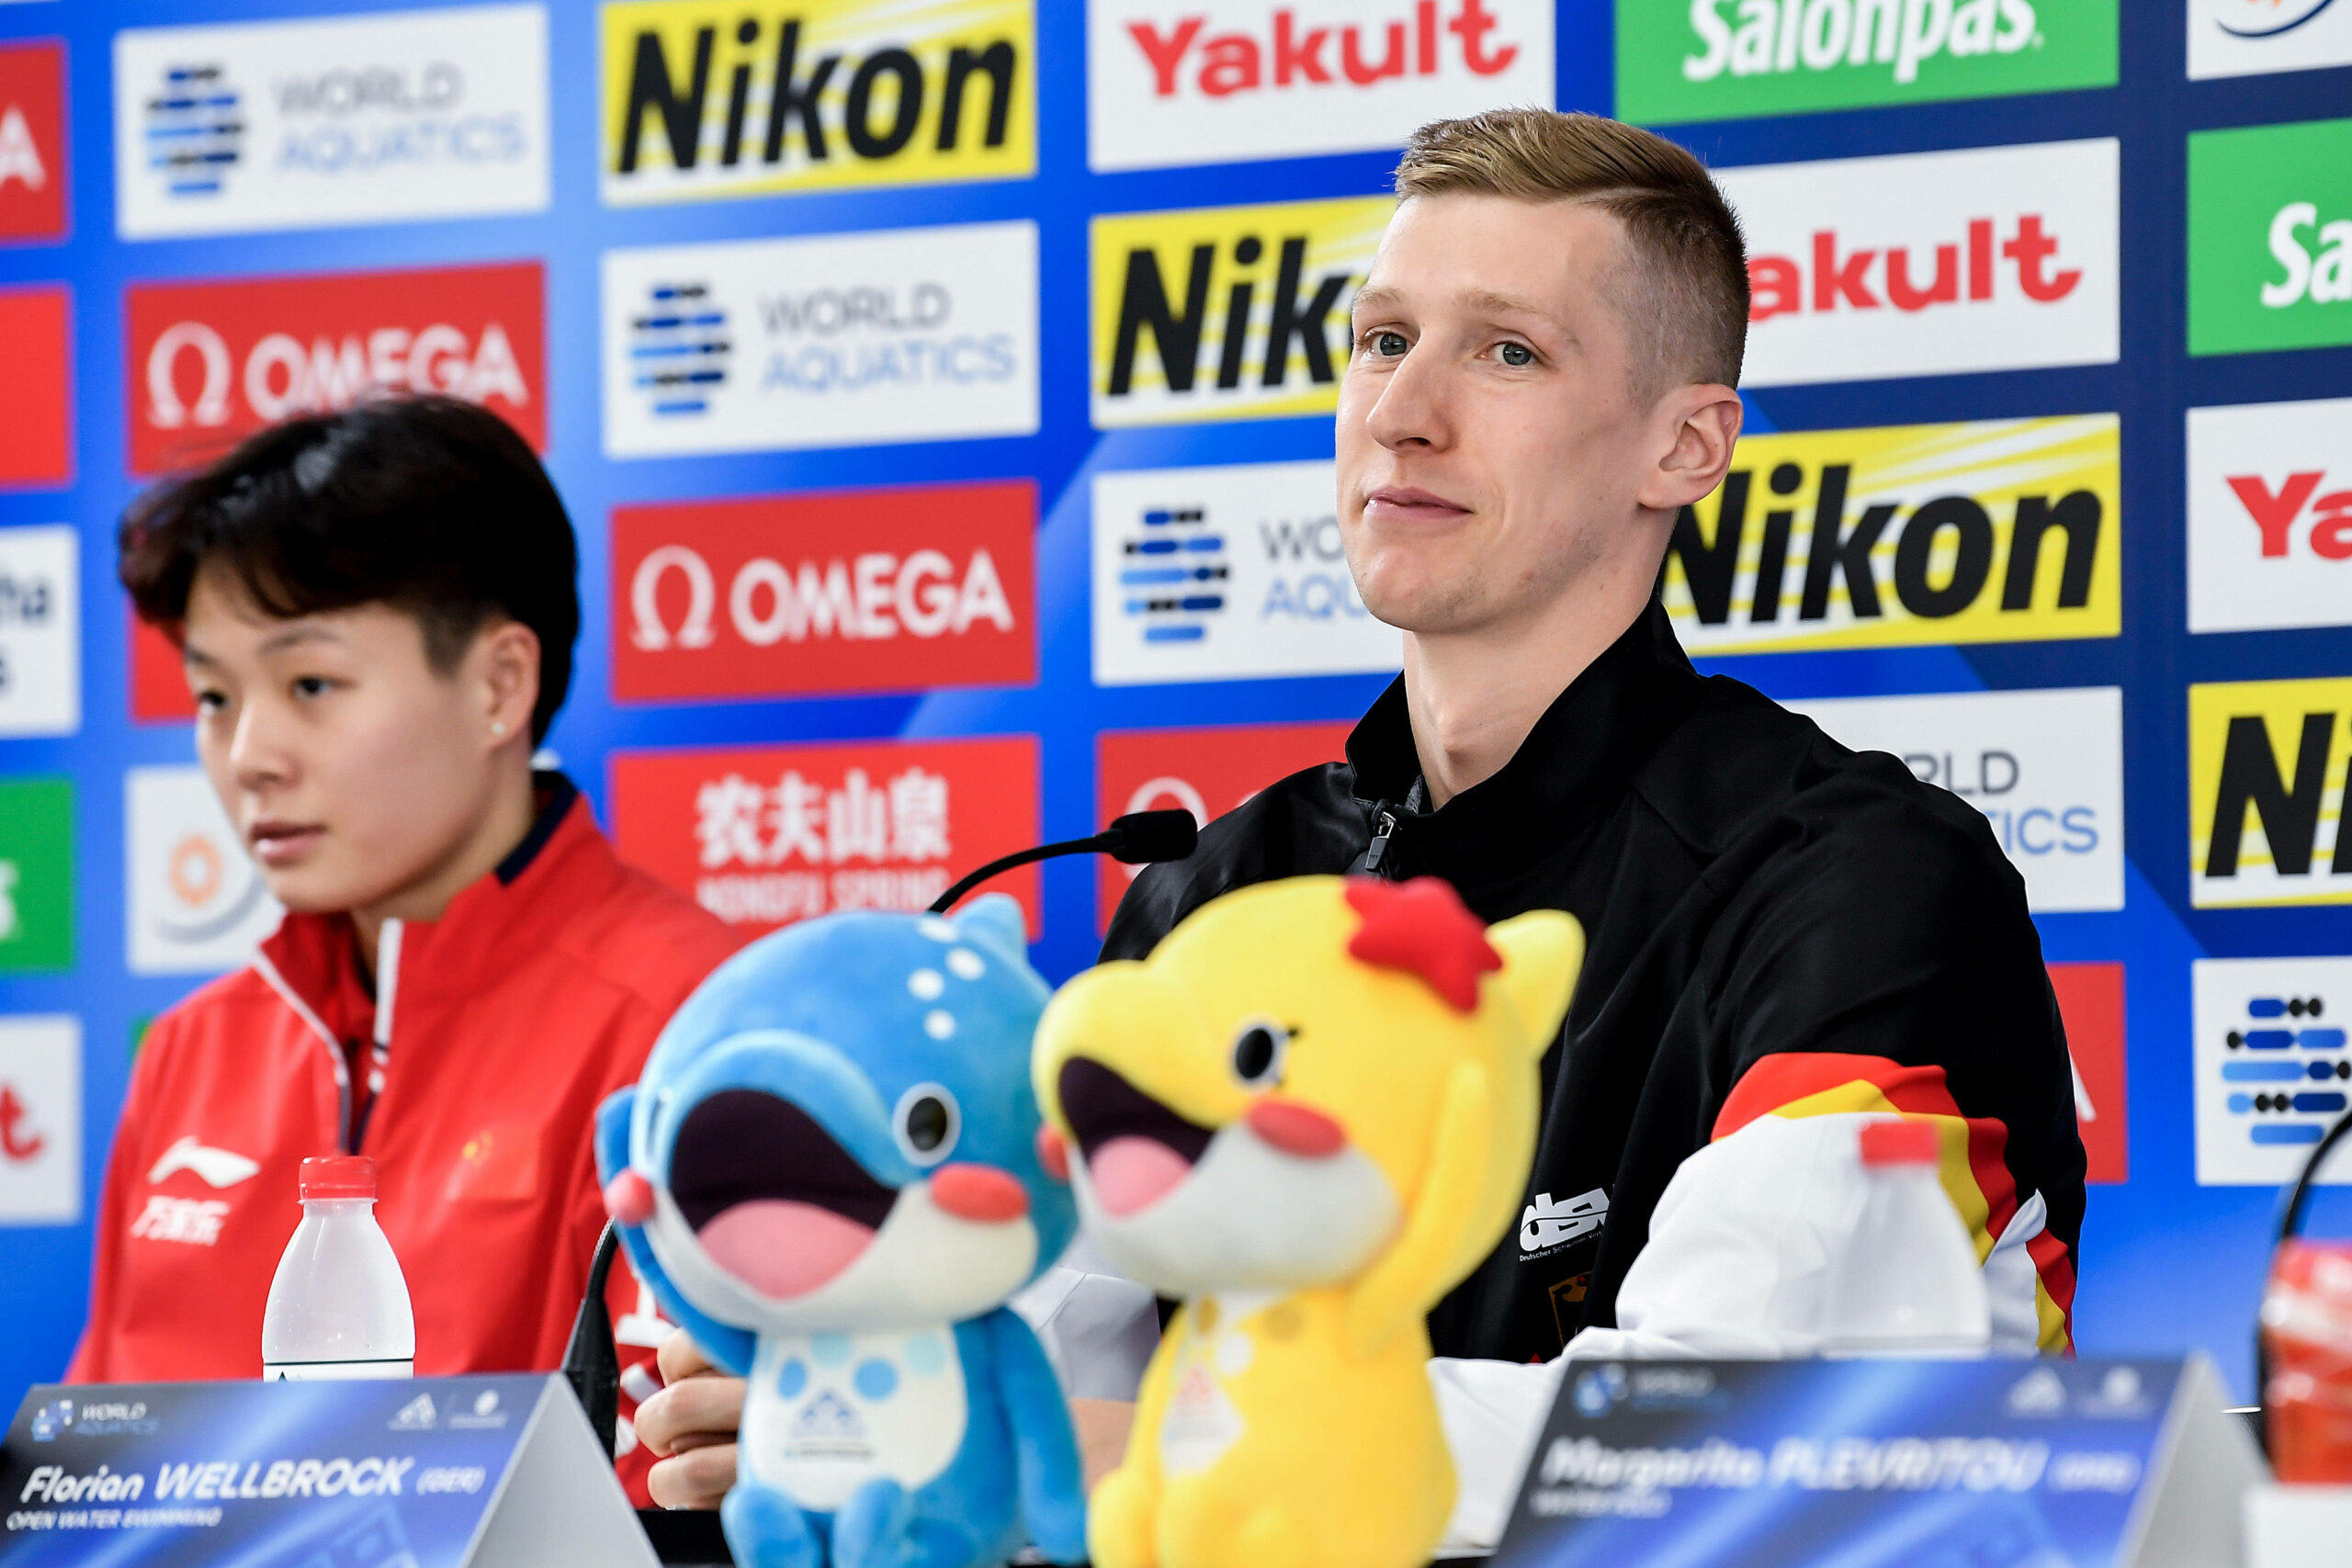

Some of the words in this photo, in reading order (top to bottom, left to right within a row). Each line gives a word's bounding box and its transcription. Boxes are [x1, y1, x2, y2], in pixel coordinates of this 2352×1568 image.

[1125, 0, 1521, 98] Yakult
[1682, 0, 2036, 82] Salonpas
[277, 64, 464, 116] WORLD
[617, 17, 1018, 175] Nikon
[279, 112, 527, 173] AQUATICS
[757, 283, 951, 337] WORLD
[1108, 235, 1354, 397] Nik
[244, 323, 530, 423] OMEGA
[760, 333, 1017, 394] AQUATICS
[1659, 463, 2103, 626] Nikon
[729, 549, 1014, 646] OMEGA
[695, 768, 951, 868] 农夫山泉
[1520, 1249, 1551, 1262] Deutscher
[20, 1464, 145, 1504] Florian
[154, 1456, 415, 1501] WELLBROCK
